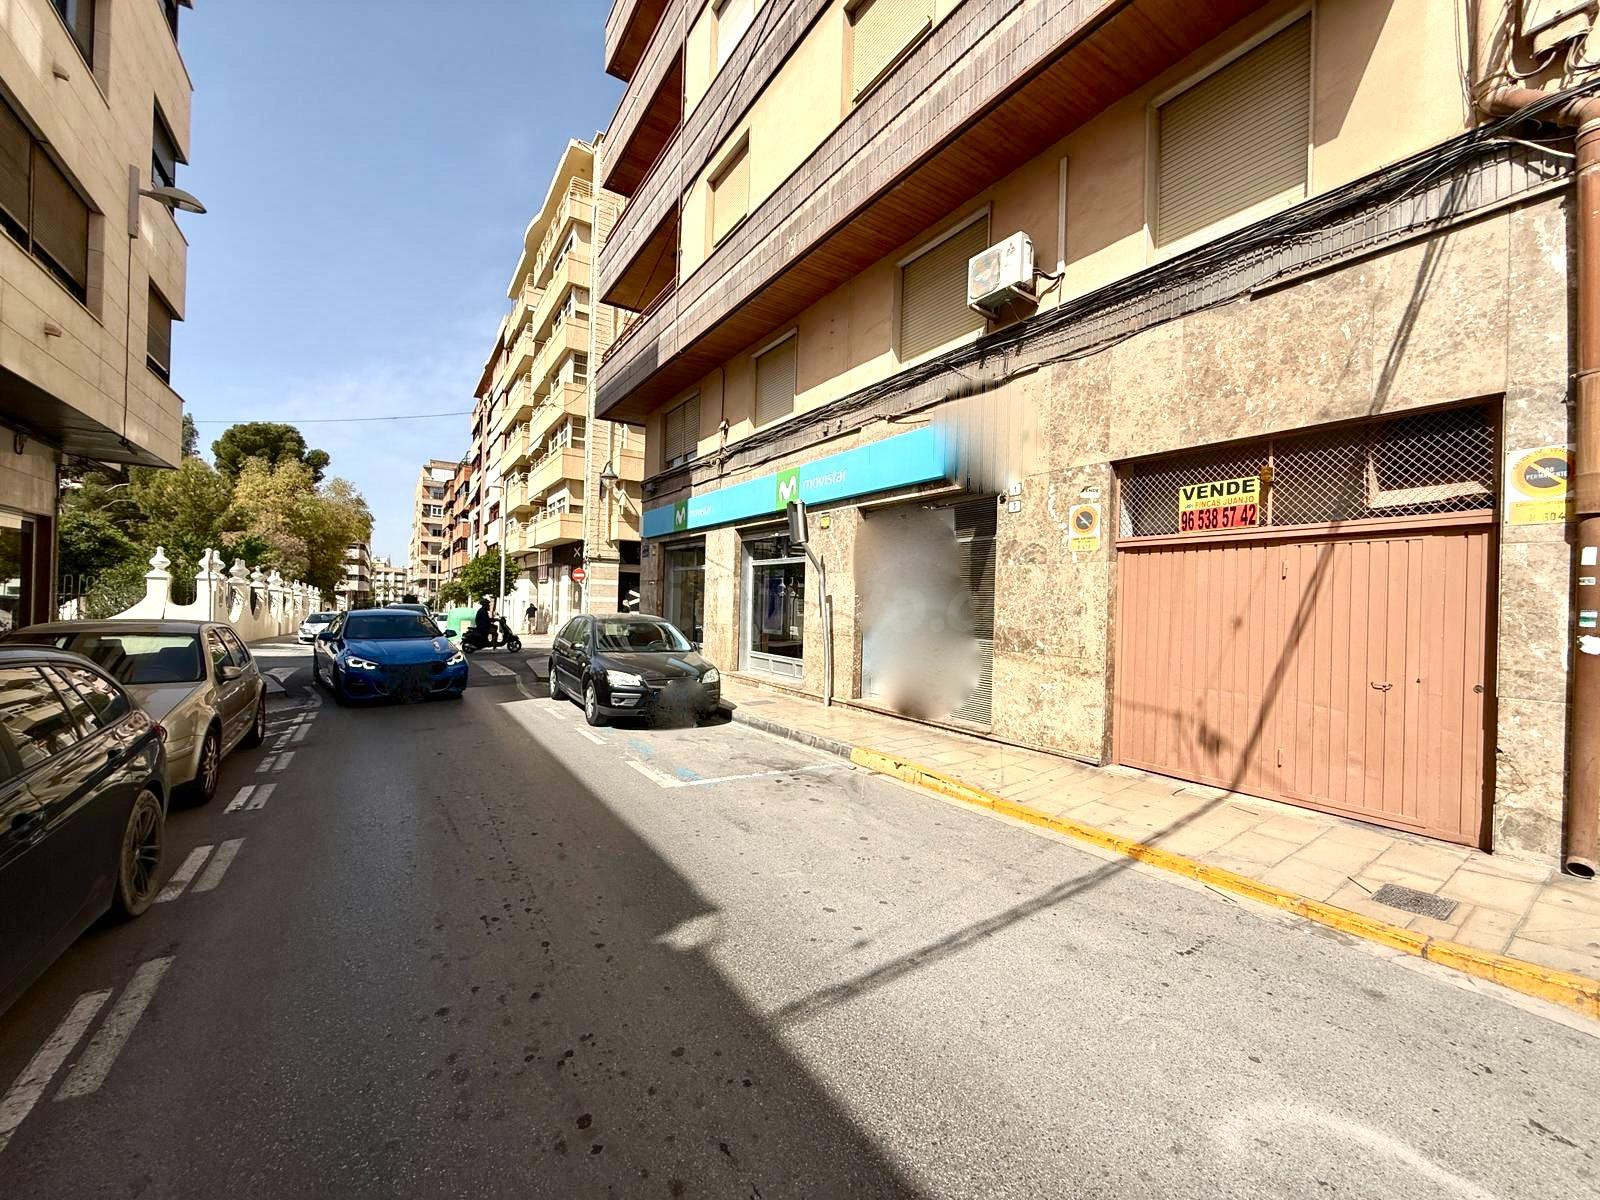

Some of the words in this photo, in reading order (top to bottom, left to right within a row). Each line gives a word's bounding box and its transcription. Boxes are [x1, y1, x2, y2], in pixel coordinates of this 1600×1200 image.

[803, 469, 847, 489] movistar
[1182, 479, 1255, 501] VENDE
[1195, 499, 1221, 509] FINCAS
[1223, 495, 1255, 506] JUANJO
[1181, 510, 1194, 531] 96
[1198, 508, 1218, 529] 538
[1222, 506, 1236, 527] 57
[1240, 504, 1256, 526] 42
